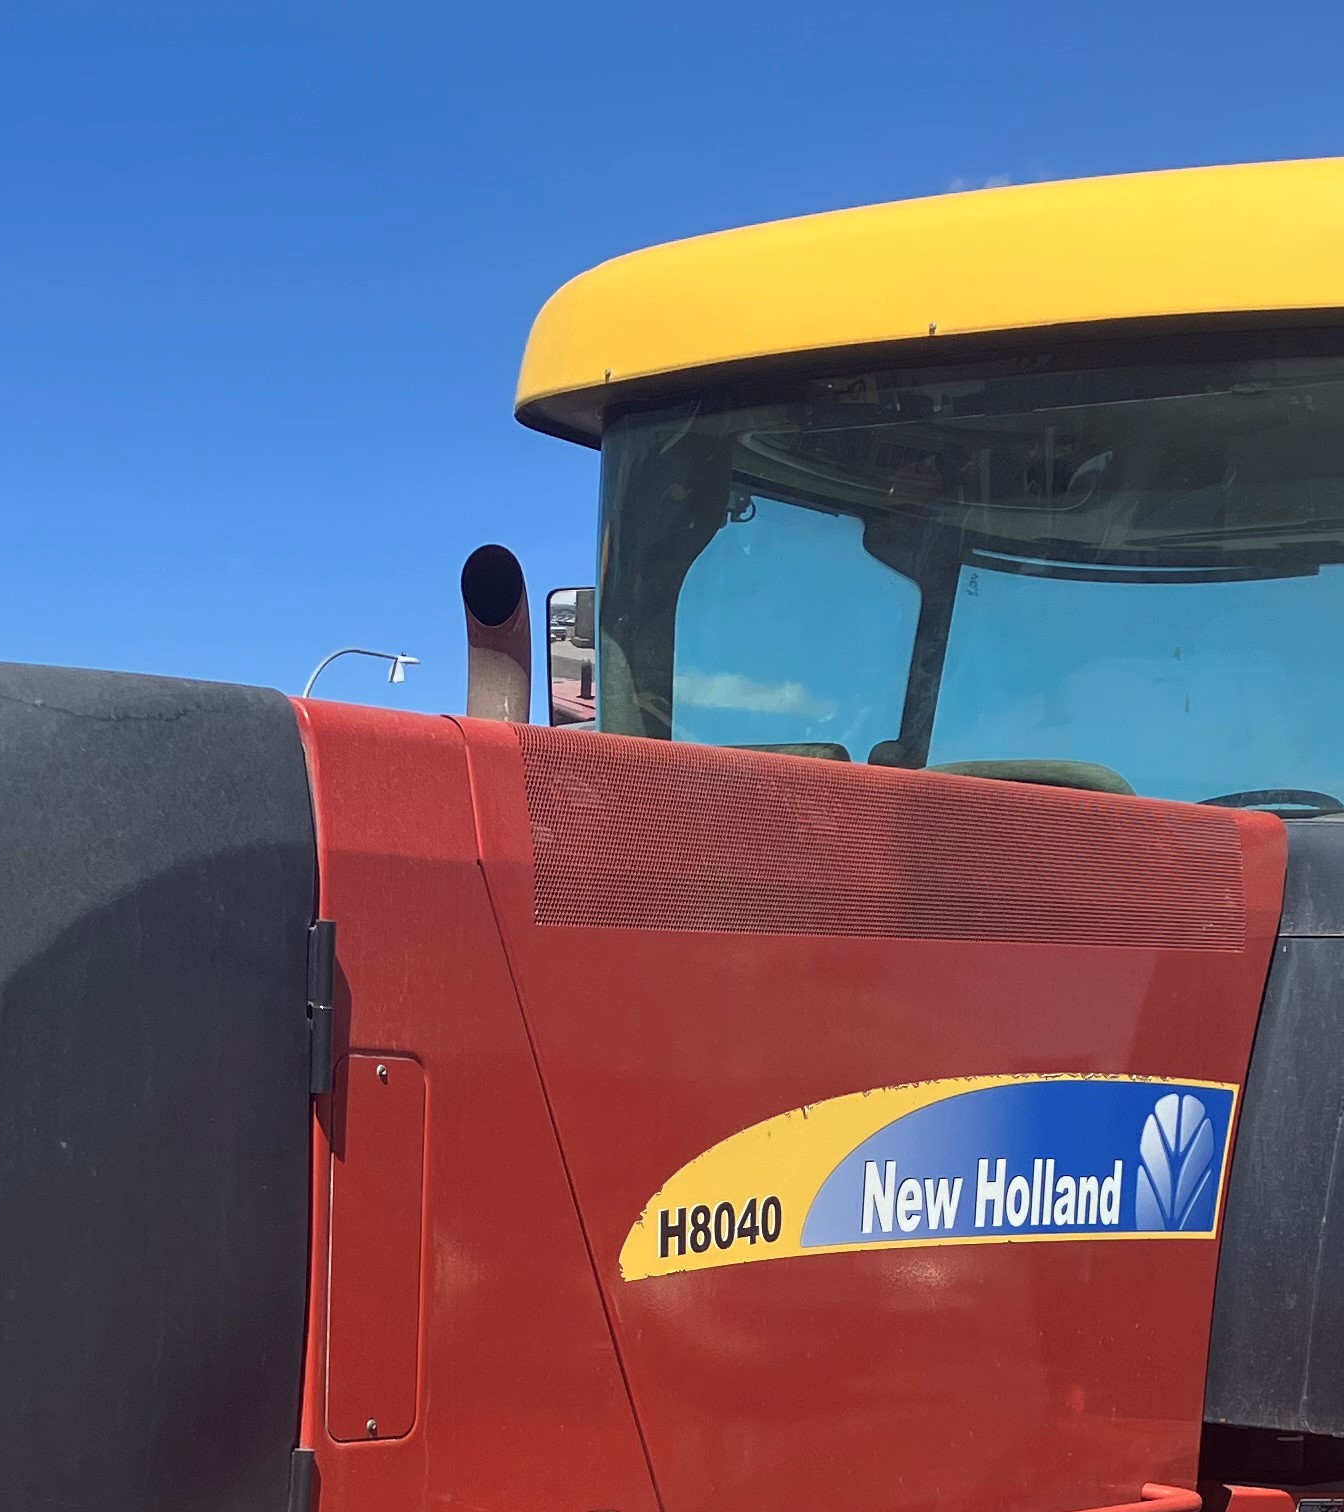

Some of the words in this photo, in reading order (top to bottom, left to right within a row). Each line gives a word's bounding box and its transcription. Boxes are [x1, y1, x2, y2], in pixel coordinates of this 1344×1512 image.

[658, 1196, 783, 1259] H8040
[860, 1159, 964, 1234] New
[973, 1157, 1124, 1228] Holland
